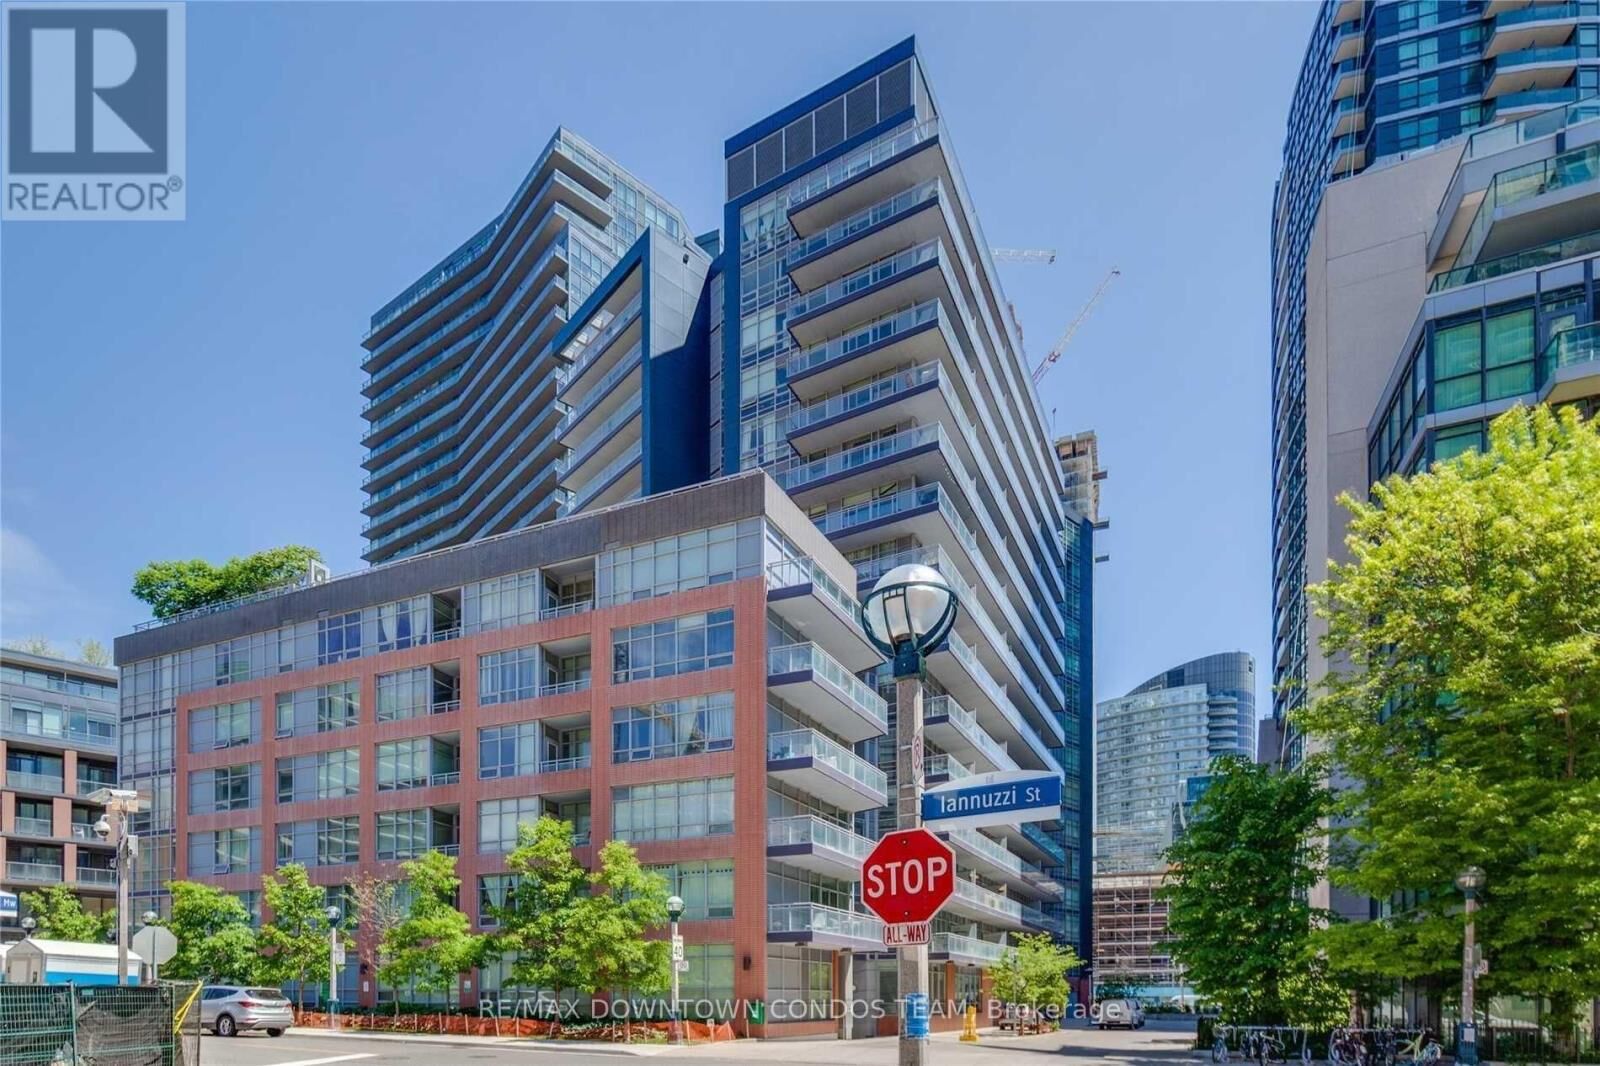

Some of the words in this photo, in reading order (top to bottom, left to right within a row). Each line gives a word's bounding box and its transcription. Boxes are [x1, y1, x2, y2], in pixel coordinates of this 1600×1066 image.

[940, 786, 1017, 814] Iannuzzi
[1025, 786, 1041, 803] St
[867, 856, 948, 898] STOP
[886, 924, 927, 944] ALL-WAY
[673, 946, 683, 957] 40
